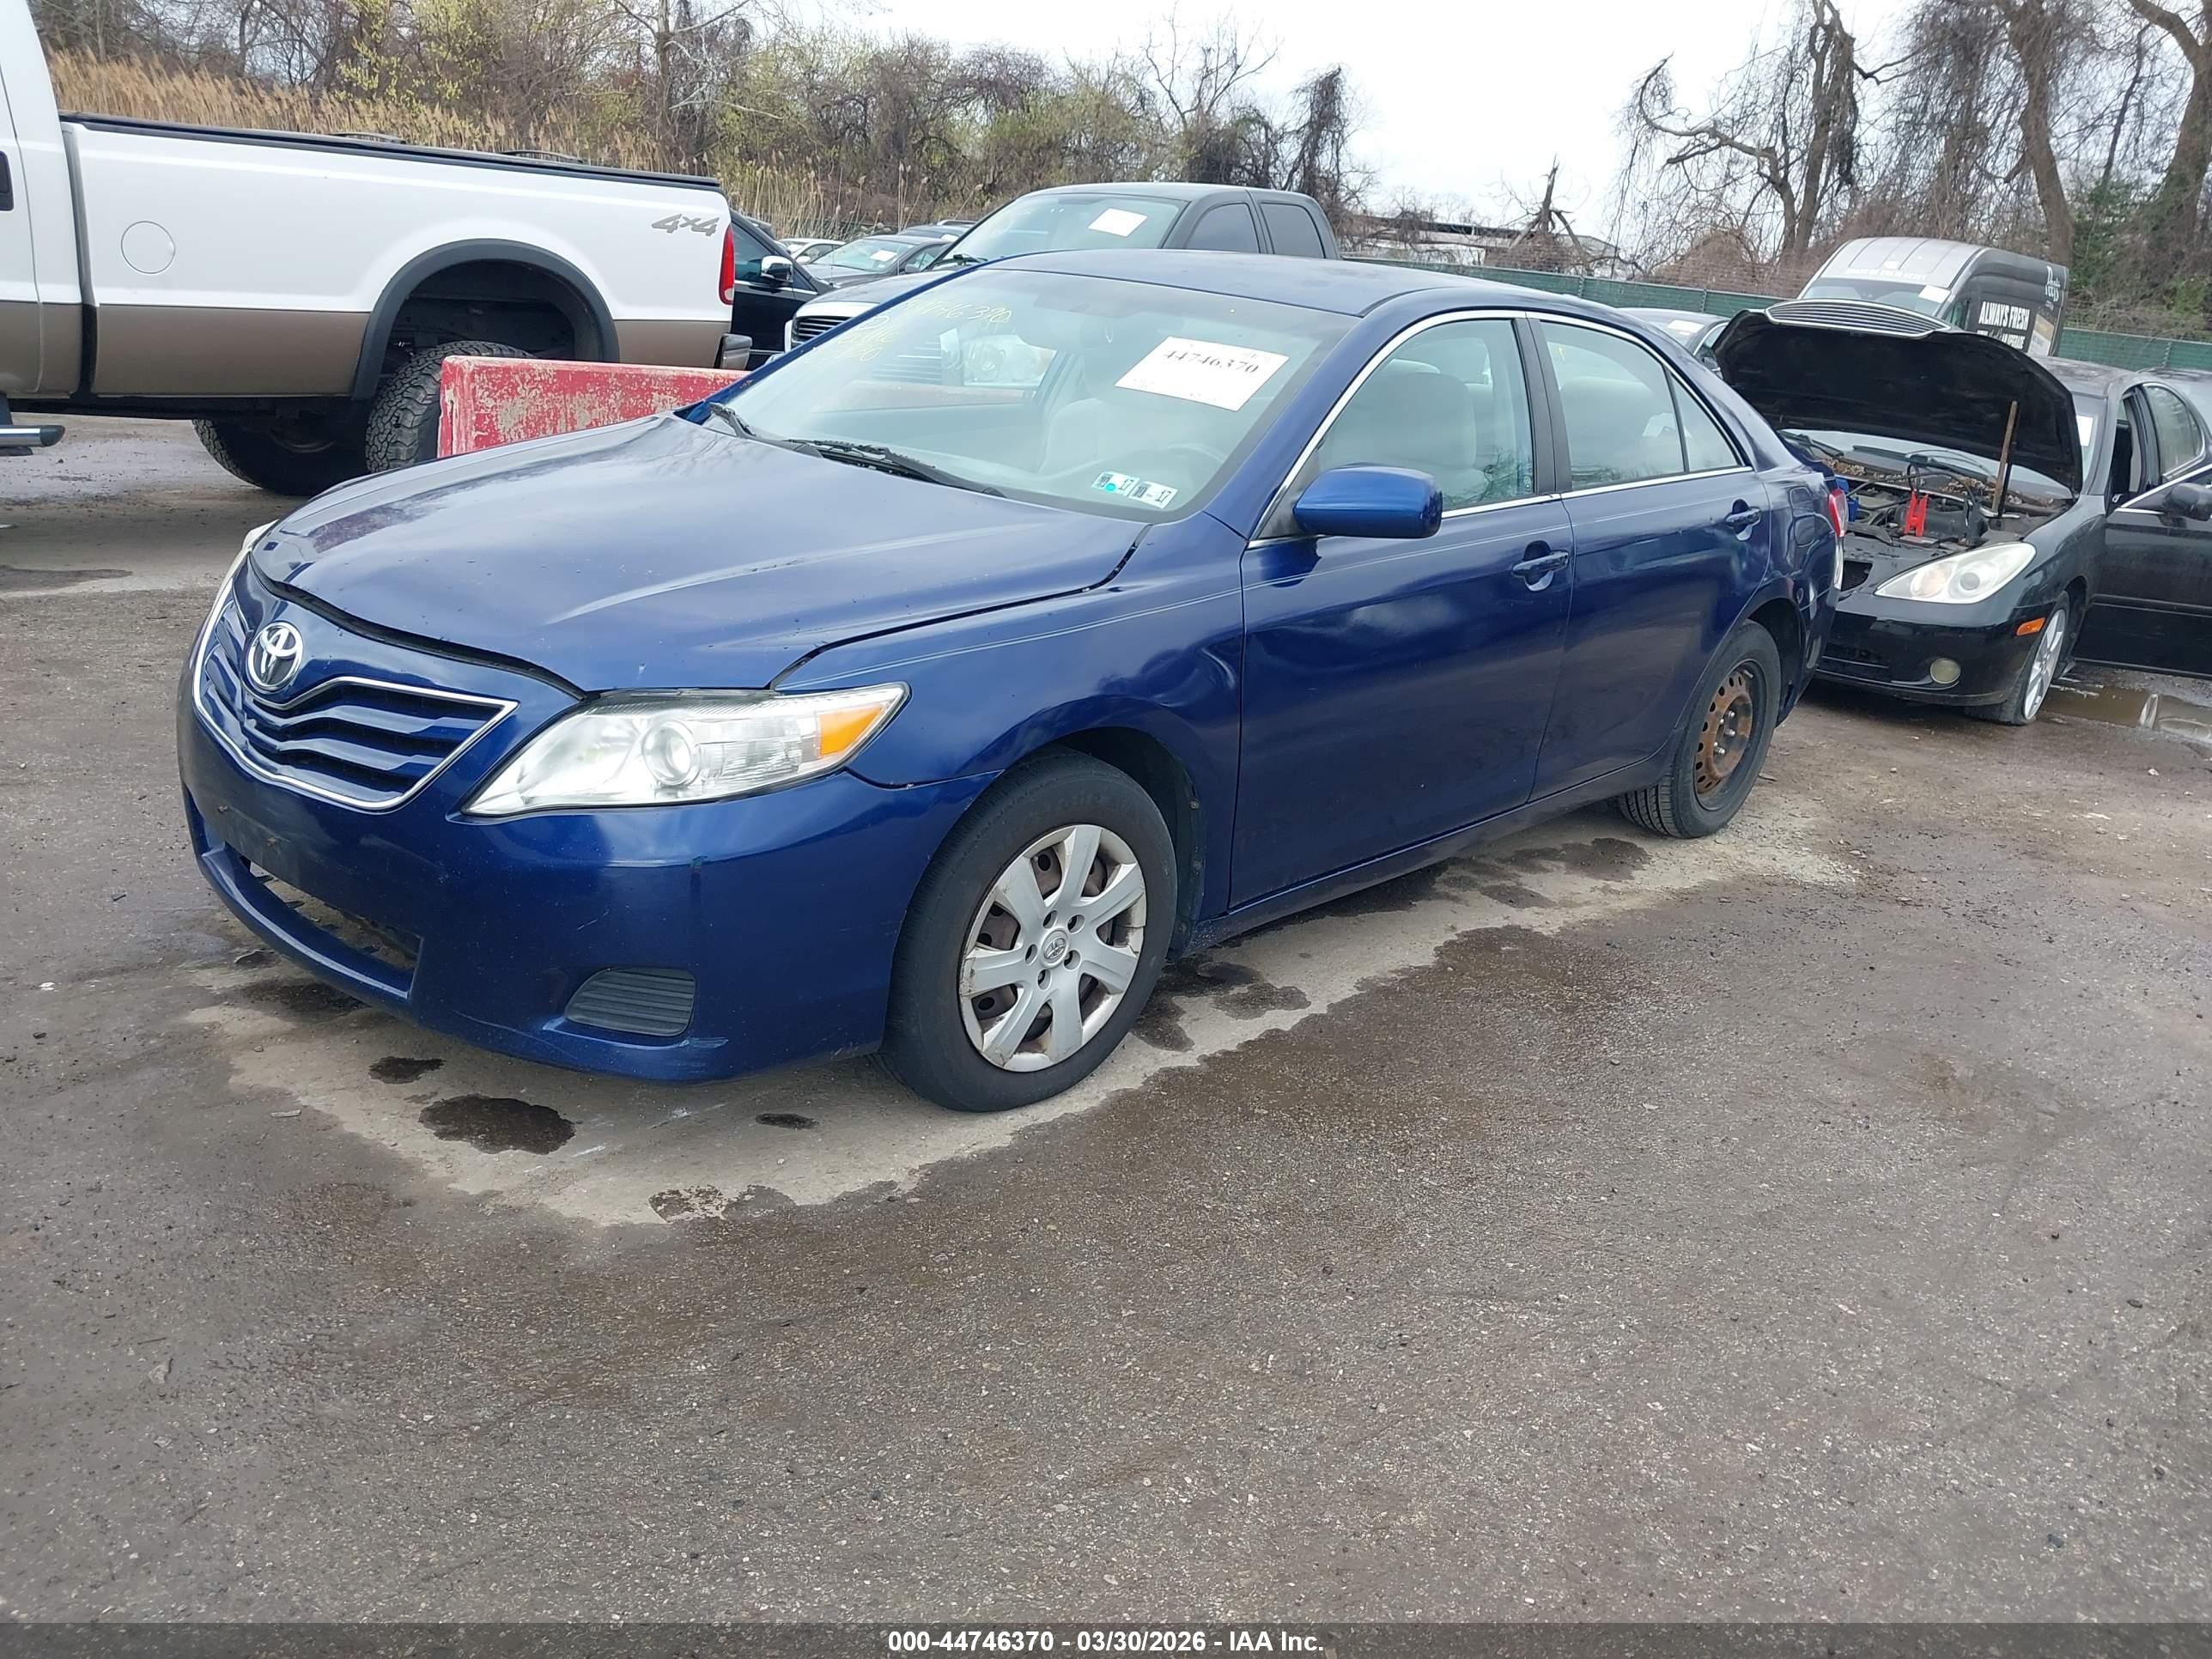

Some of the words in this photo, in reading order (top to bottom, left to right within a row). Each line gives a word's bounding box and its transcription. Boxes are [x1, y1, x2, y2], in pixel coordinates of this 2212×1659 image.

[651, 213, 720, 236] 4x4
[1978, 301, 2010, 327] ALWAYS
[2008, 306, 2031, 331] FRESH
[1164, 349, 1259, 373] 44746370
[1118, 478, 1134, 491] 17
[1155, 489, 1173, 503] 17
